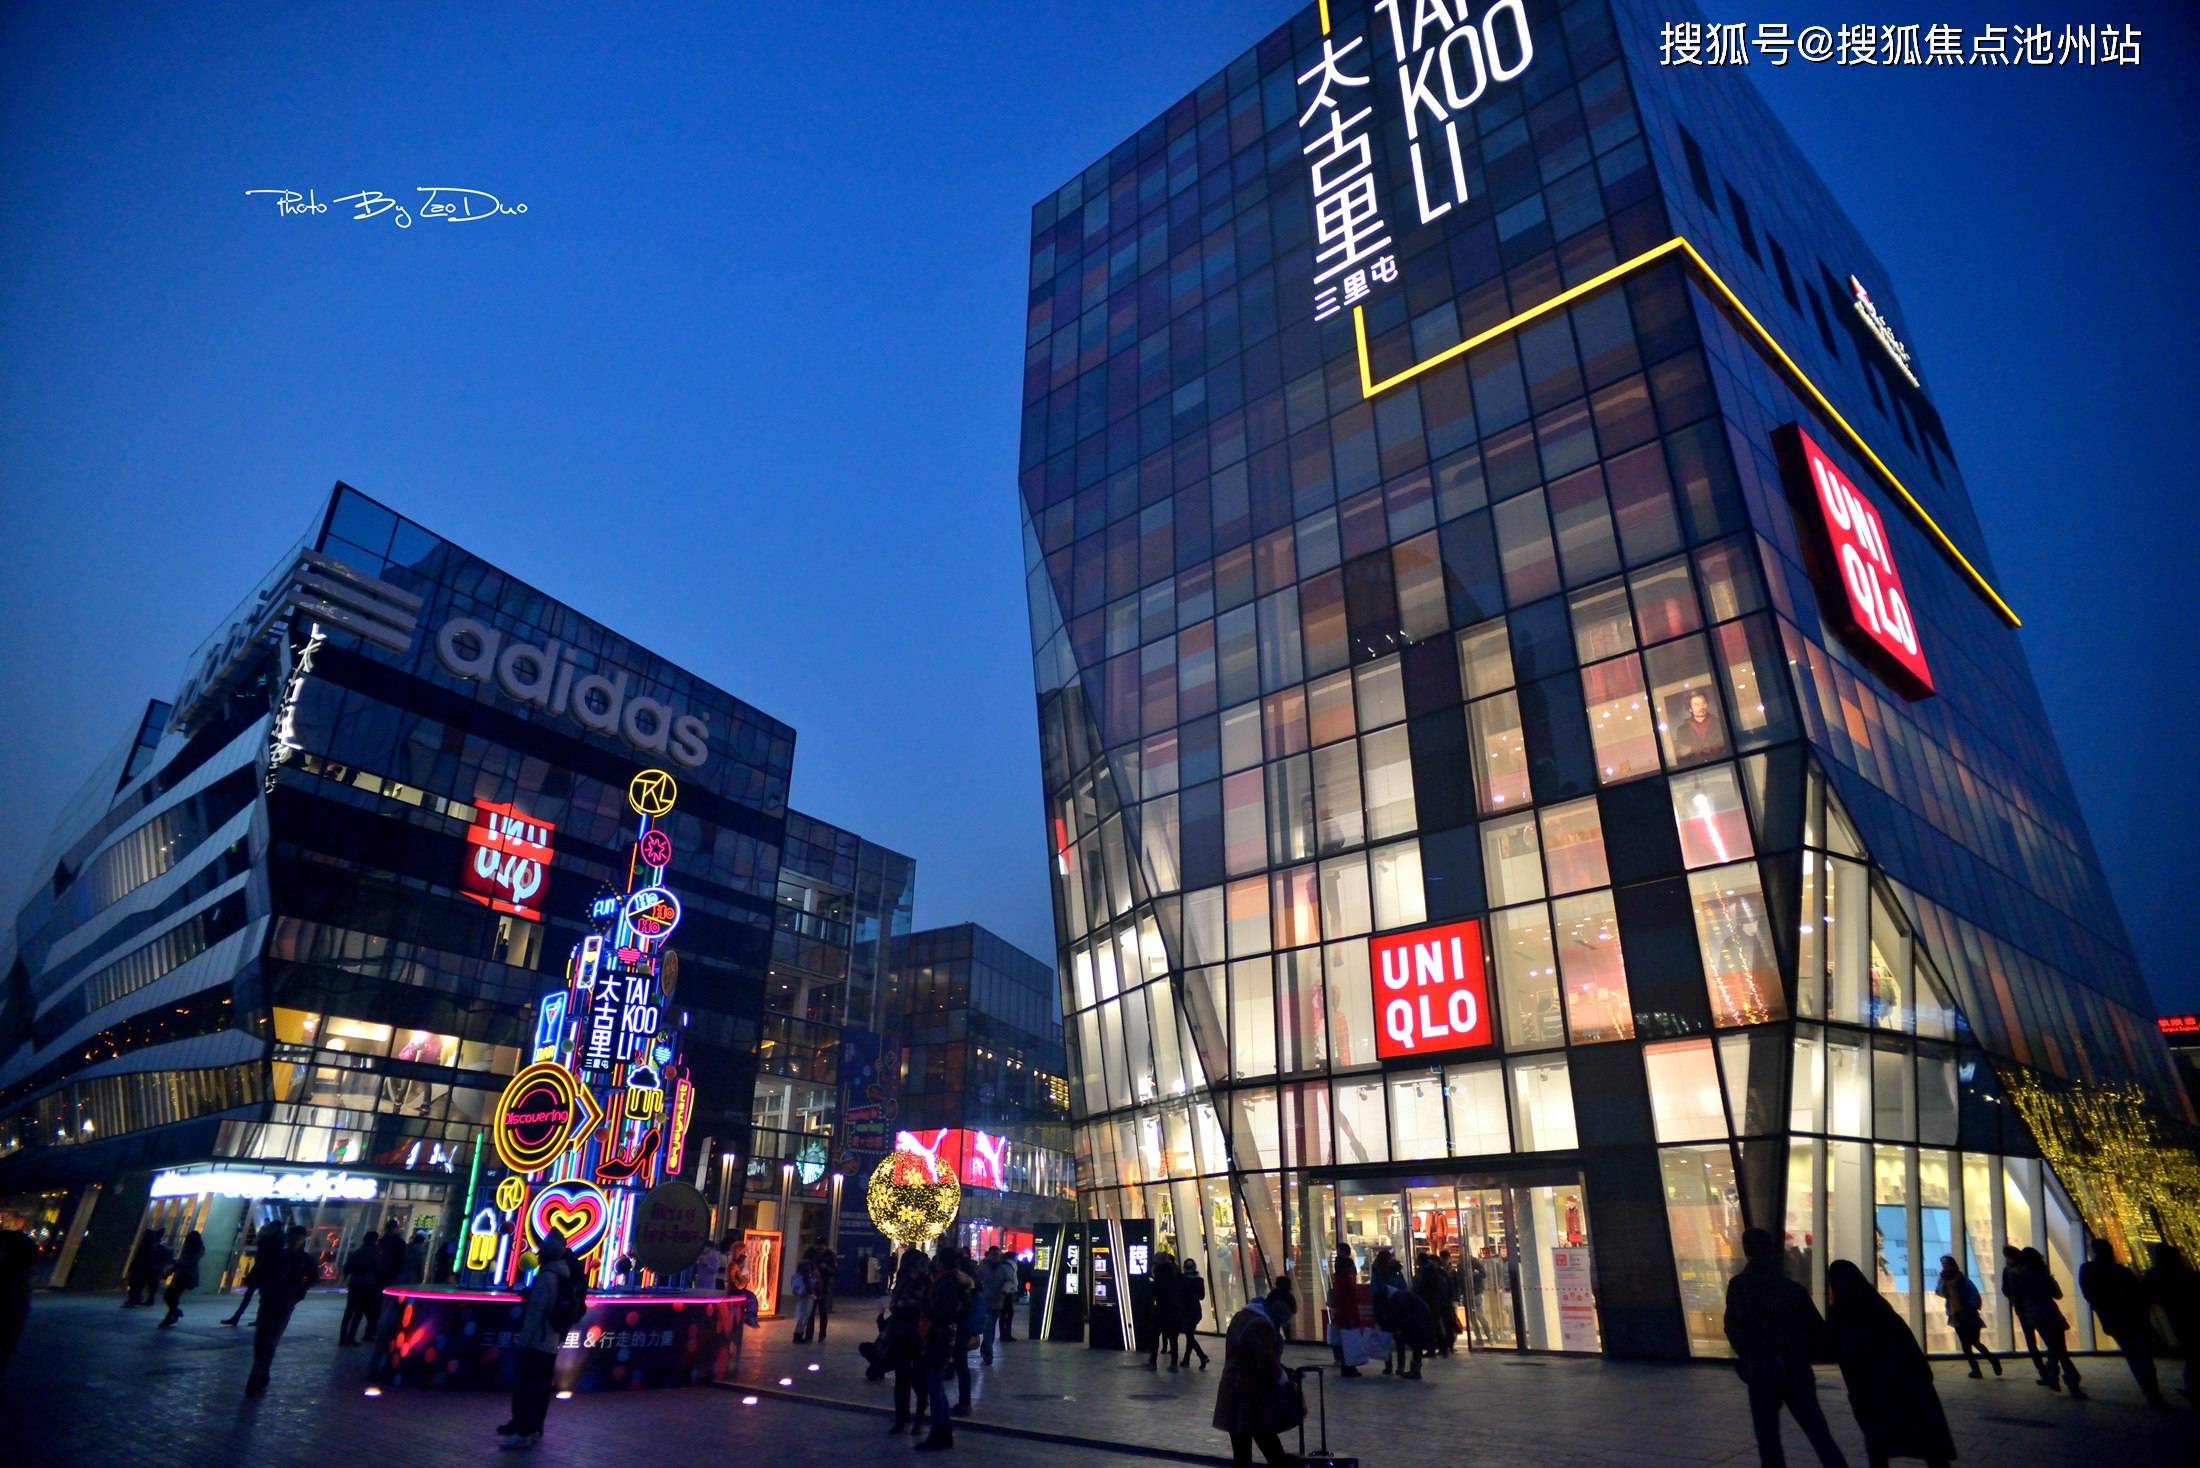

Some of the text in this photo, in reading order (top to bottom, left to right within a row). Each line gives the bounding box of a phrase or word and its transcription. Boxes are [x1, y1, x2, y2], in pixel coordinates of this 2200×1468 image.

[1400, 0, 1533, 140] KOO
[1297, 37, 1391, 285] 太古里
[1410, 121, 1468, 225] LI
[1314, 254, 1398, 322] 三里屯
[1814, 456, 1891, 575] UNI
[1841, 543, 1917, 656] QLO
[436, 617, 710, 768] adidas
[625, 976, 650, 1005] TAI
[1381, 936, 1465, 990] UNI
[586, 974, 622, 1058] 太古里
[616, 1032, 634, 1060] LI
[621, 1004, 658, 1034] KOO
[1386, 988, 1477, 1050] QLO
